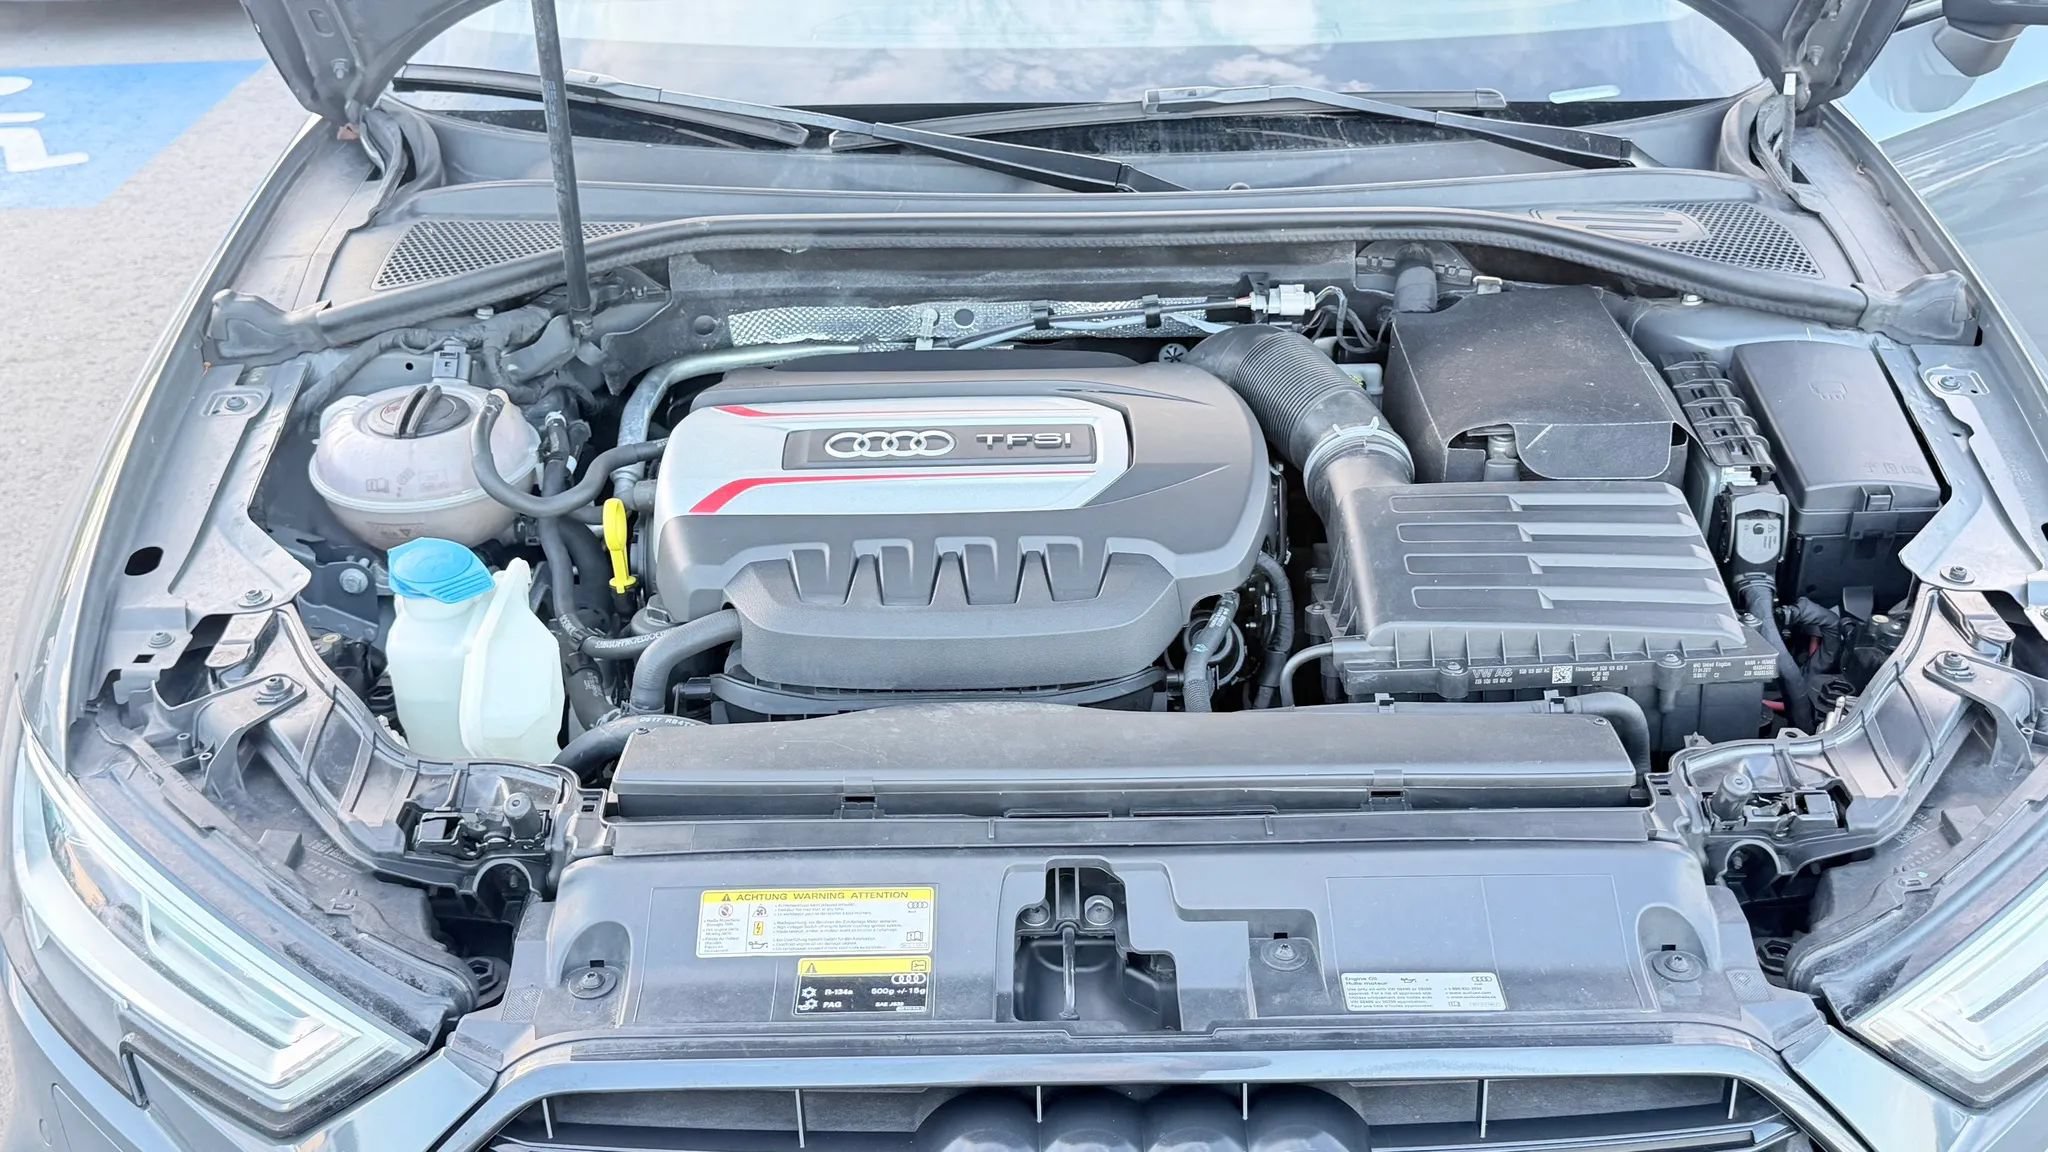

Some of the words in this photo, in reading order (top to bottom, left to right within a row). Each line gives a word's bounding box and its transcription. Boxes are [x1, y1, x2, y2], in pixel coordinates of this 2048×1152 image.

[976, 432, 1072, 450] TFSI
[1472, 668, 1493, 679] VW
[1494, 667, 1514, 678] AG
[736, 892, 788, 902] ACHTUNG
[793, 891, 845, 901] WARNING
[850, 890, 909, 900] ATTENTION
[822, 1001, 842, 1009] PAG
